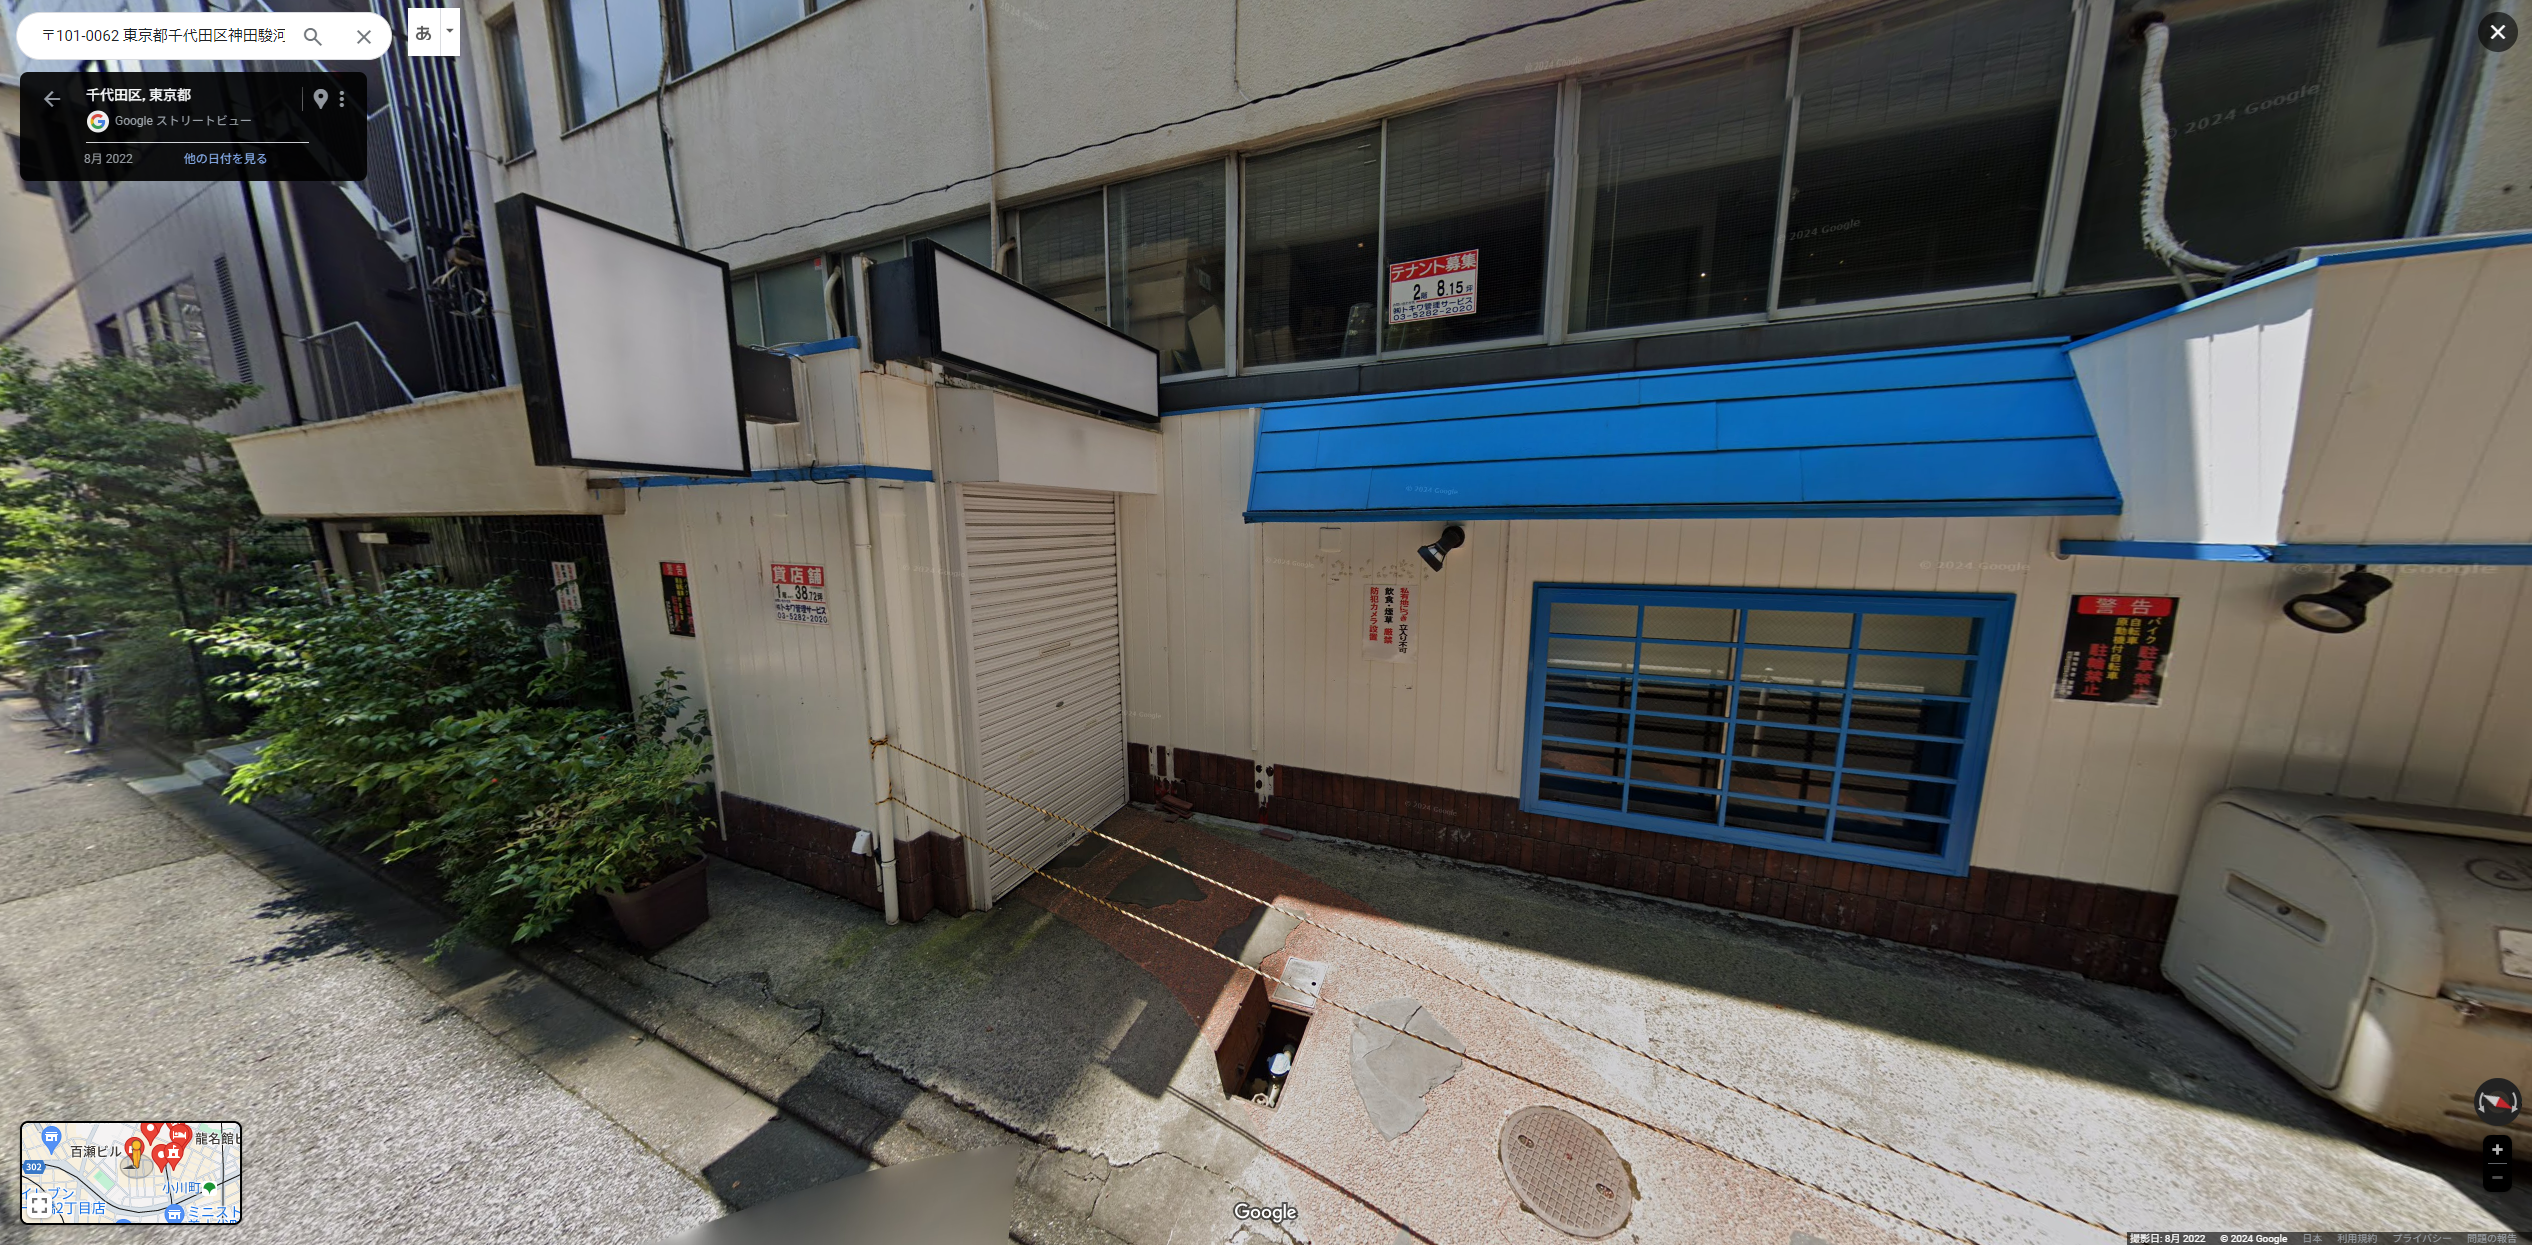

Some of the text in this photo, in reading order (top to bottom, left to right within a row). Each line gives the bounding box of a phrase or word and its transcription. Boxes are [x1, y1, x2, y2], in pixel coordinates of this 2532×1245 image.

[1391, 252, 1477, 281] テナント募集
[1392, 304, 1474, 321] 03-5282-2020
[772, 565, 823, 586] 貸店舗
[777, 611, 828, 624] 03-5282-2020
[1369, 586, 1379, 641] 防犯カメラ設置
[2095, 597, 2154, 615] 警告
[1398, 624, 1409, 654] 立入り不可
[2146, 616, 2162, 644] バイク
